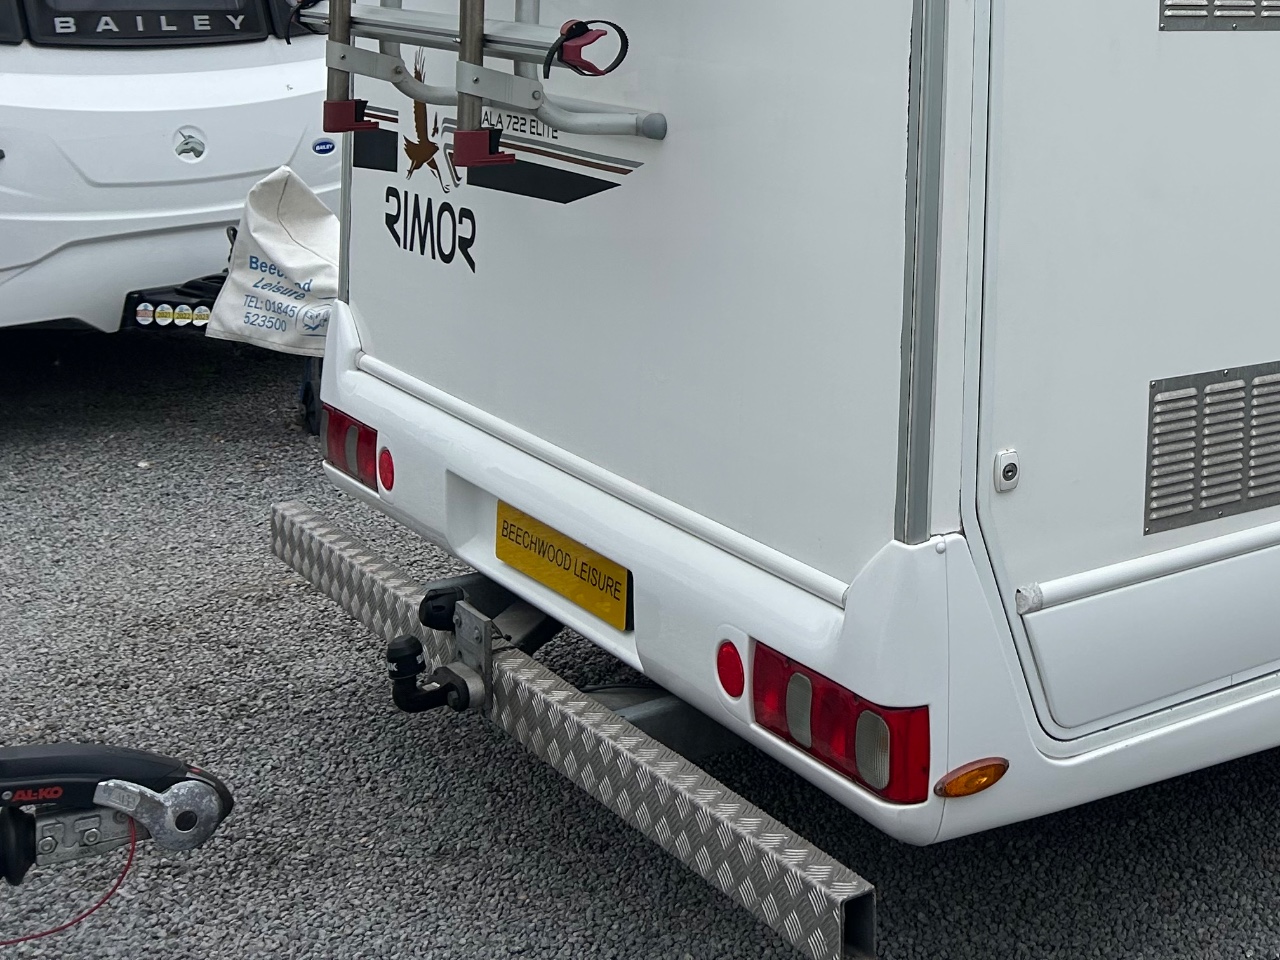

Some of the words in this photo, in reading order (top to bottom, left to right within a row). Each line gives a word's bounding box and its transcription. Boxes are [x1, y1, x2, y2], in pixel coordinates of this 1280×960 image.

[54, 15, 245, 34] BAILEY
[506, 114, 527, 134] 722
[385, 186, 476, 274] RIMOR
[252, 277, 307, 301] Leisure
[176, 312, 191, 320] 2022
[264, 299, 298, 318] 01845
[243, 311, 287, 332] 523500
[501, 519, 572, 571] BEECHWOOD
[573, 557, 622, 602] LEISURE
[11, 786, 63, 802] AL-KO
